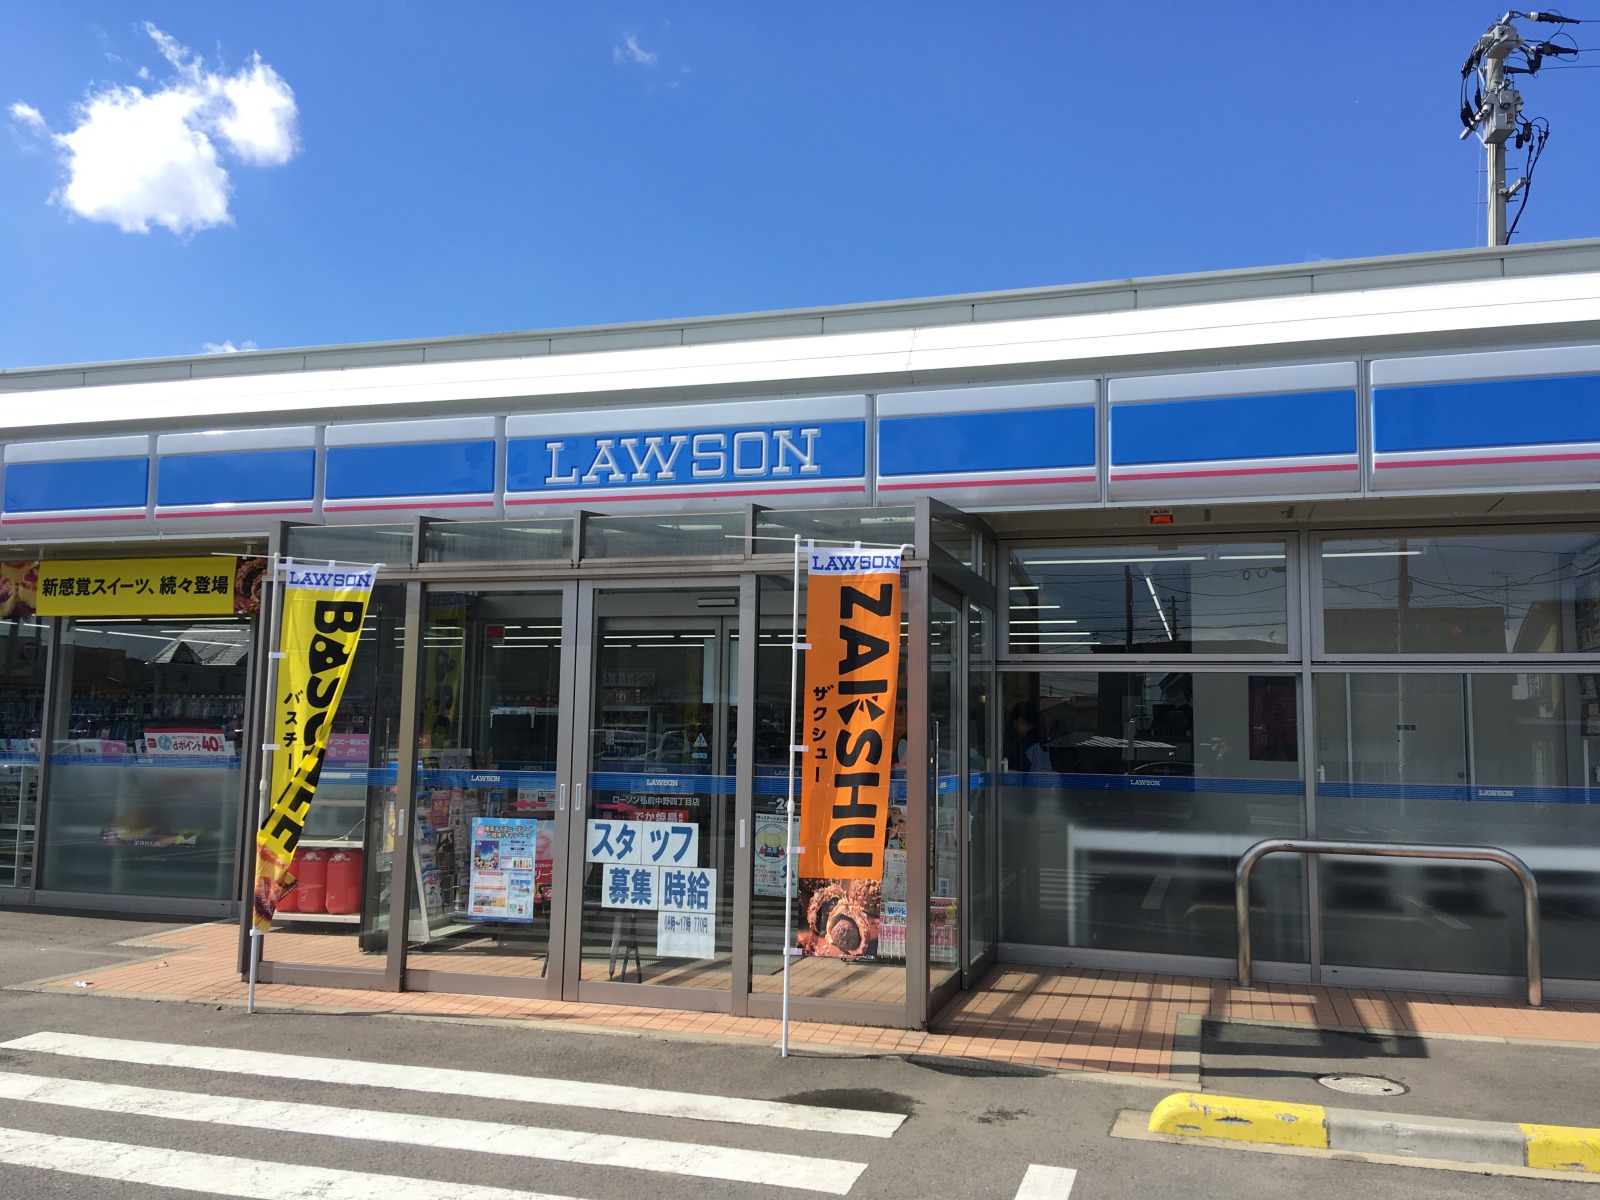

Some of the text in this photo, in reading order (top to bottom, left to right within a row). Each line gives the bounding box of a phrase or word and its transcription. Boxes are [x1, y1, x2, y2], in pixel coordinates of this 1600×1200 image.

[545, 427, 821, 485] LAWSON
[812, 555, 900, 571] LAWSON
[42, 575, 229, 597] 新感覚スイーツ、続々登場
[289, 571, 372, 587] LAWSON
[283, 690, 304, 770] バスチー
[811, 684, 834, 783] ザクシュー
[829, 583, 893, 868] ZAKSHU
[646, 779, 679, 787] LAWSON
[1478, 789, 1514, 797] LAWSON
[612, 795, 700, 807] ローソン弘前中野四丁目店
[592, 823, 694, 863] スタッフ
[608, 867, 652, 905] 募集
[664, 869, 710, 910] 時給
